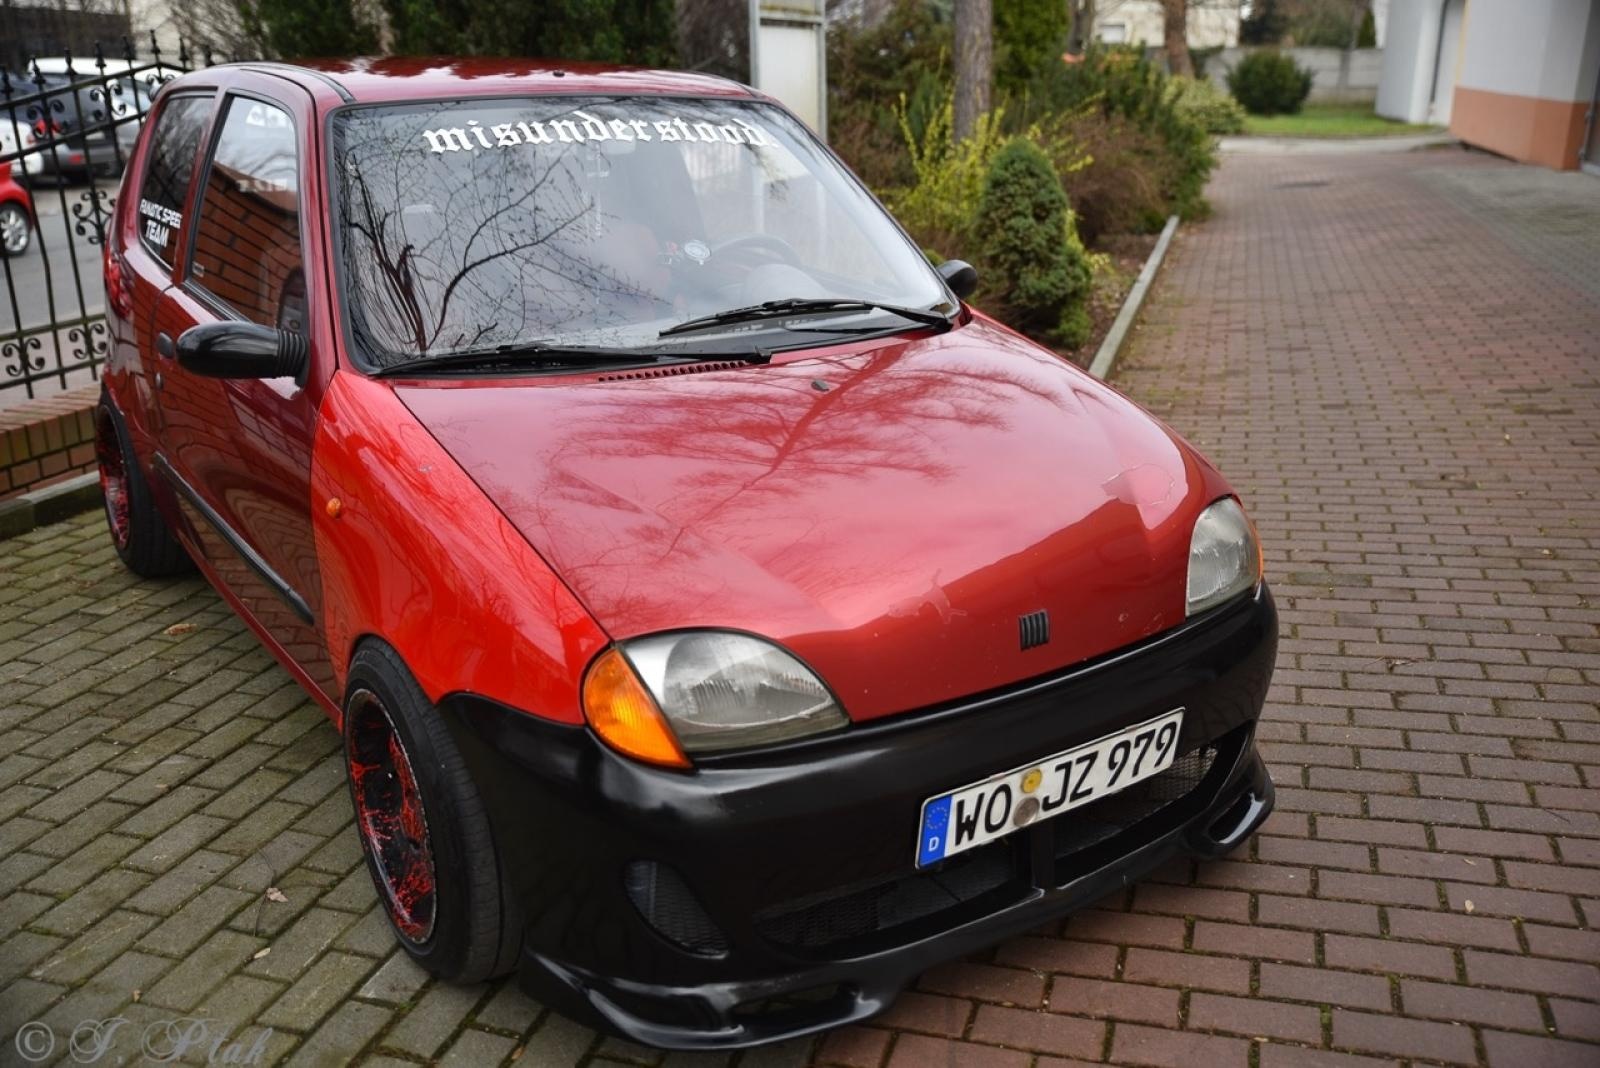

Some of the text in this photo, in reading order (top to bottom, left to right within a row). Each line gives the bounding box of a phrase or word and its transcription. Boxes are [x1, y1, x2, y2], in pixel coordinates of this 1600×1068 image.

[145, 219, 170, 248] TEAM
[954, 721, 1178, 846] WO JZ 979
[928, 836, 940, 852] D
